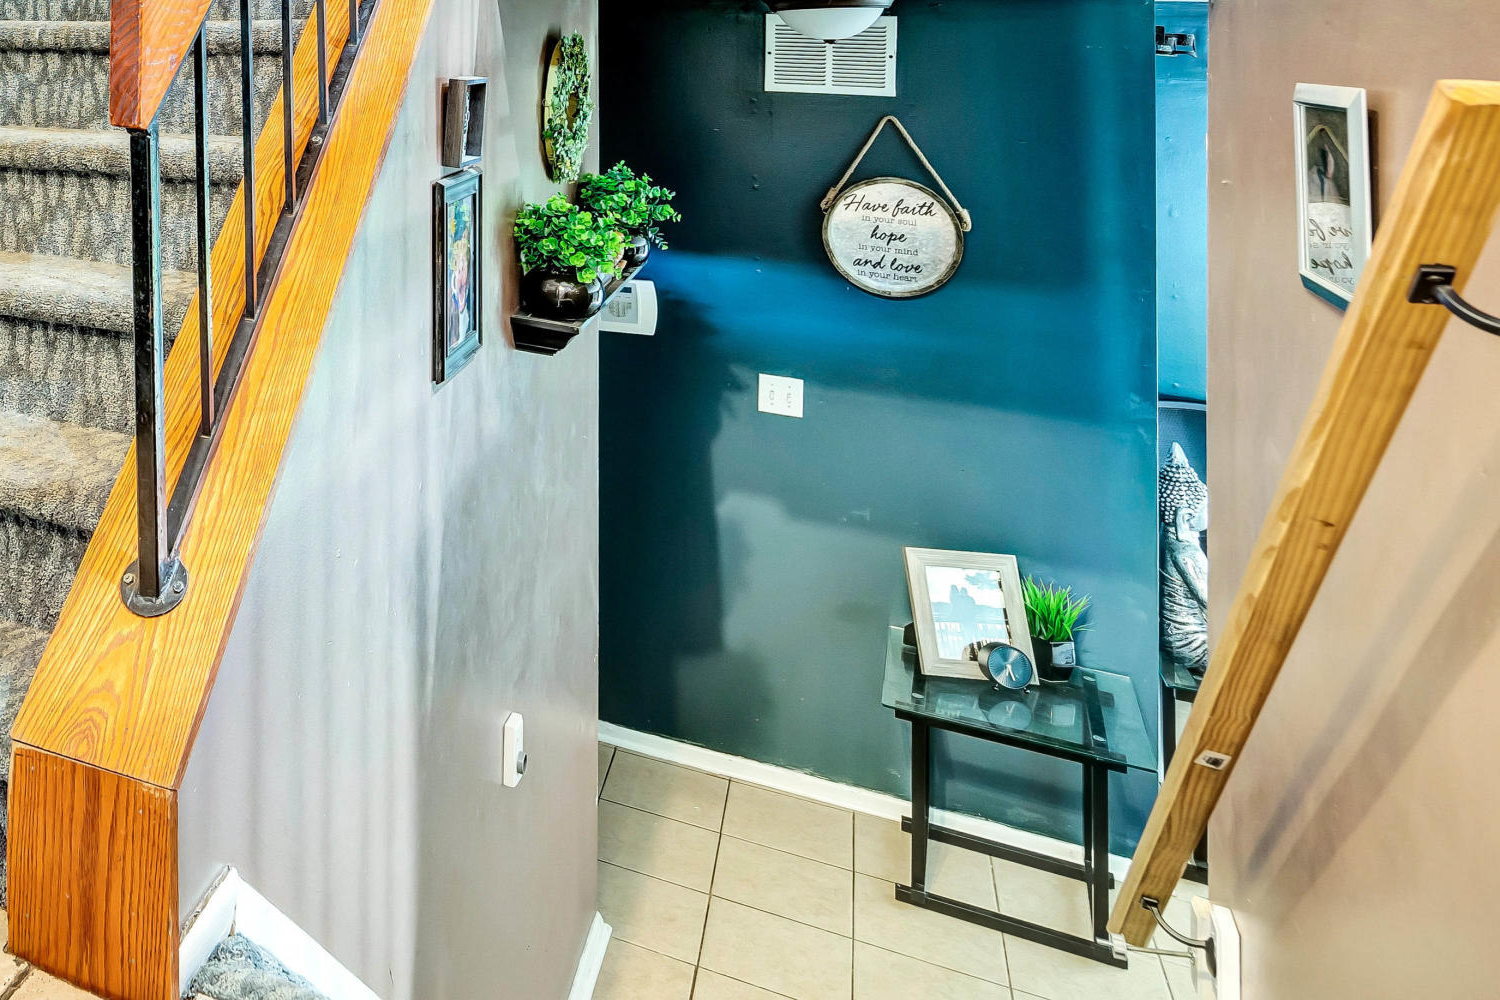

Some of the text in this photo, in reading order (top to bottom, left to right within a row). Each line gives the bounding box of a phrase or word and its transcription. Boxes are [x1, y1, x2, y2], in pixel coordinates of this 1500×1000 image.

[843, 193, 937, 218] Have faith
[872, 216, 895, 224] your
[897, 218, 917, 227] soul
[870, 224, 908, 246] hope
[858, 243, 919, 256] in your mind
[852, 254, 923, 274] and love
[868, 271, 891, 279] your
[893, 273, 918, 283] heart
